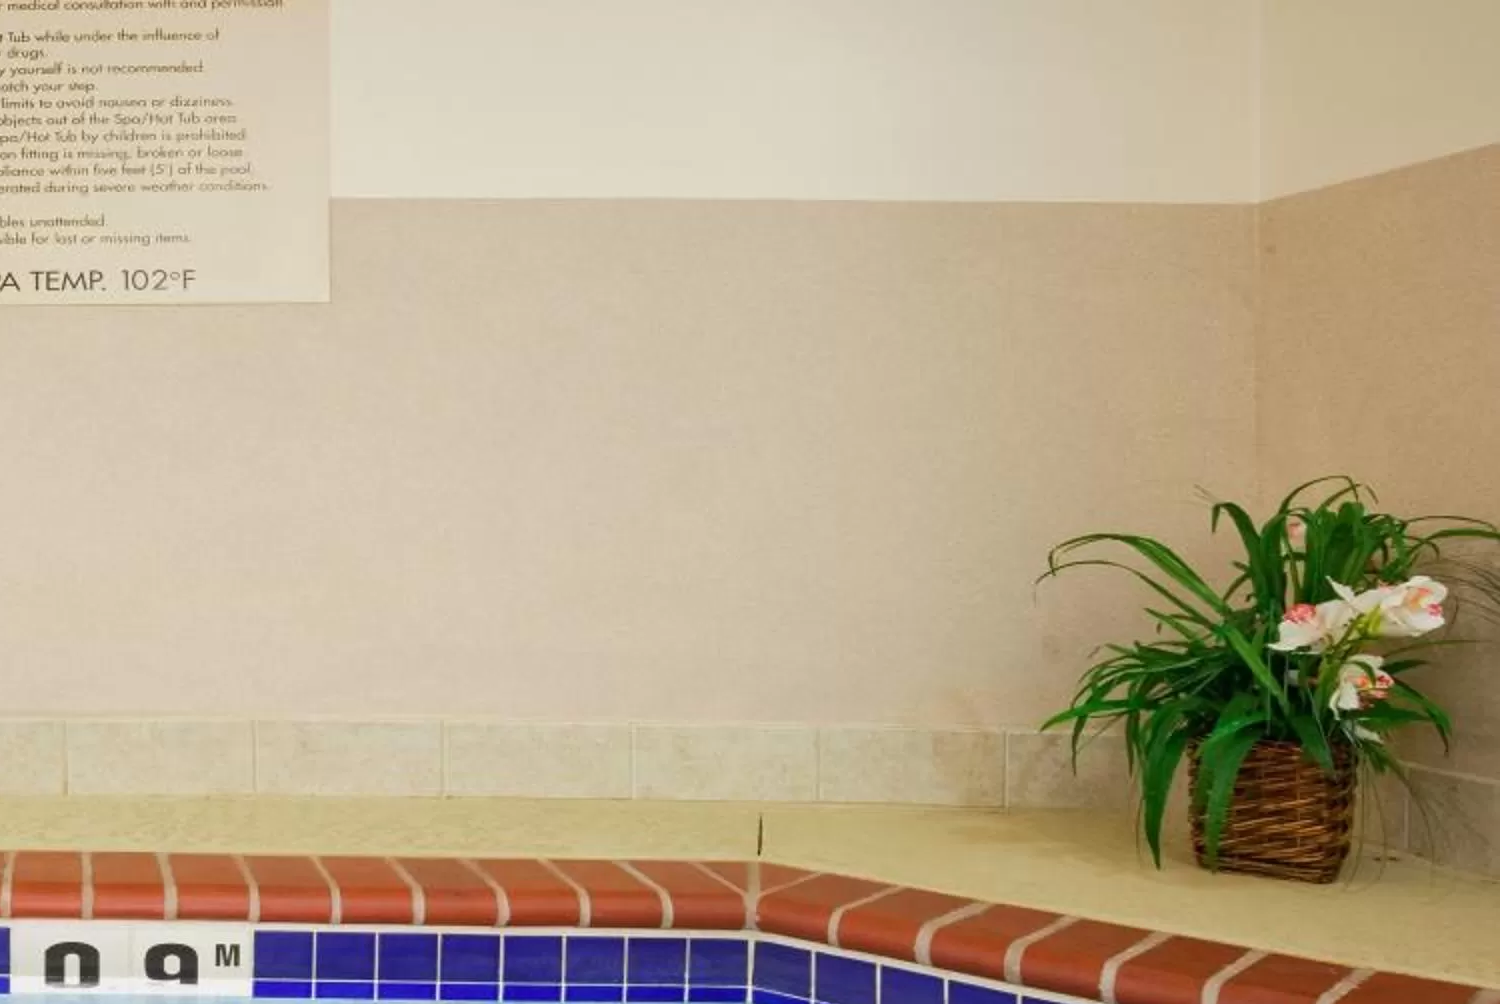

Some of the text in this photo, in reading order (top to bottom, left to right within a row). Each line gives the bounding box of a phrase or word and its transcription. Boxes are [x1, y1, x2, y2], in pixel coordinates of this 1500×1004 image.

[7, 0, 60, 11] medical
[180, 0, 207, 8] and
[7, 31, 31, 43] Tub
[34, 31, 71, 42] while
[74, 30, 113, 43] under
[117, 29, 138, 40] the
[142, 29, 202, 40] influence
[206, 28, 219, 40] of
[9, 62, 63, 78] yourself
[67, 64, 77, 74] is
[81, 64, 103, 75] not
[32, 83, 64, 95] your
[0, 97, 35, 109] limits
[39, 99, 53, 109] to
[55, 96, 95, 109] avoid
[99, 100, 147, 108] nausea
[45, 115, 69, 125] out
[71, 113, 86, 125] of
[89, 113, 110, 124] the
[114, 112, 173, 126] Spa/Hot
[177, 112, 201, 124] Tub
[54, 130, 77, 143] Tub
[81, 130, 99, 144] by
[102, 129, 157, 142] children
[161, 131, 172, 140] is
[20, 146, 59, 162] fitting
[63, 148, 73, 159] is
[137, 146, 184, 158] broken
[188, 149, 202, 158] or
[48, 164, 89, 175] within
[93, 163, 117, 176] five
[121, 163, 146, 174] feet
[177, 163, 192, 174] of
[195, 163, 216, 174] the
[44, 182, 89, 194] during
[93, 184, 135, 192] severe
[141, 181, 193, 192] weather
[31, 232, 48, 244] for
[54, 233, 77, 244] lost
[81, 236, 96, 244] or
[100, 236, 150, 246] missing
[29, 270, 106, 291] TEMP.
[215, 944, 240, 966] M
